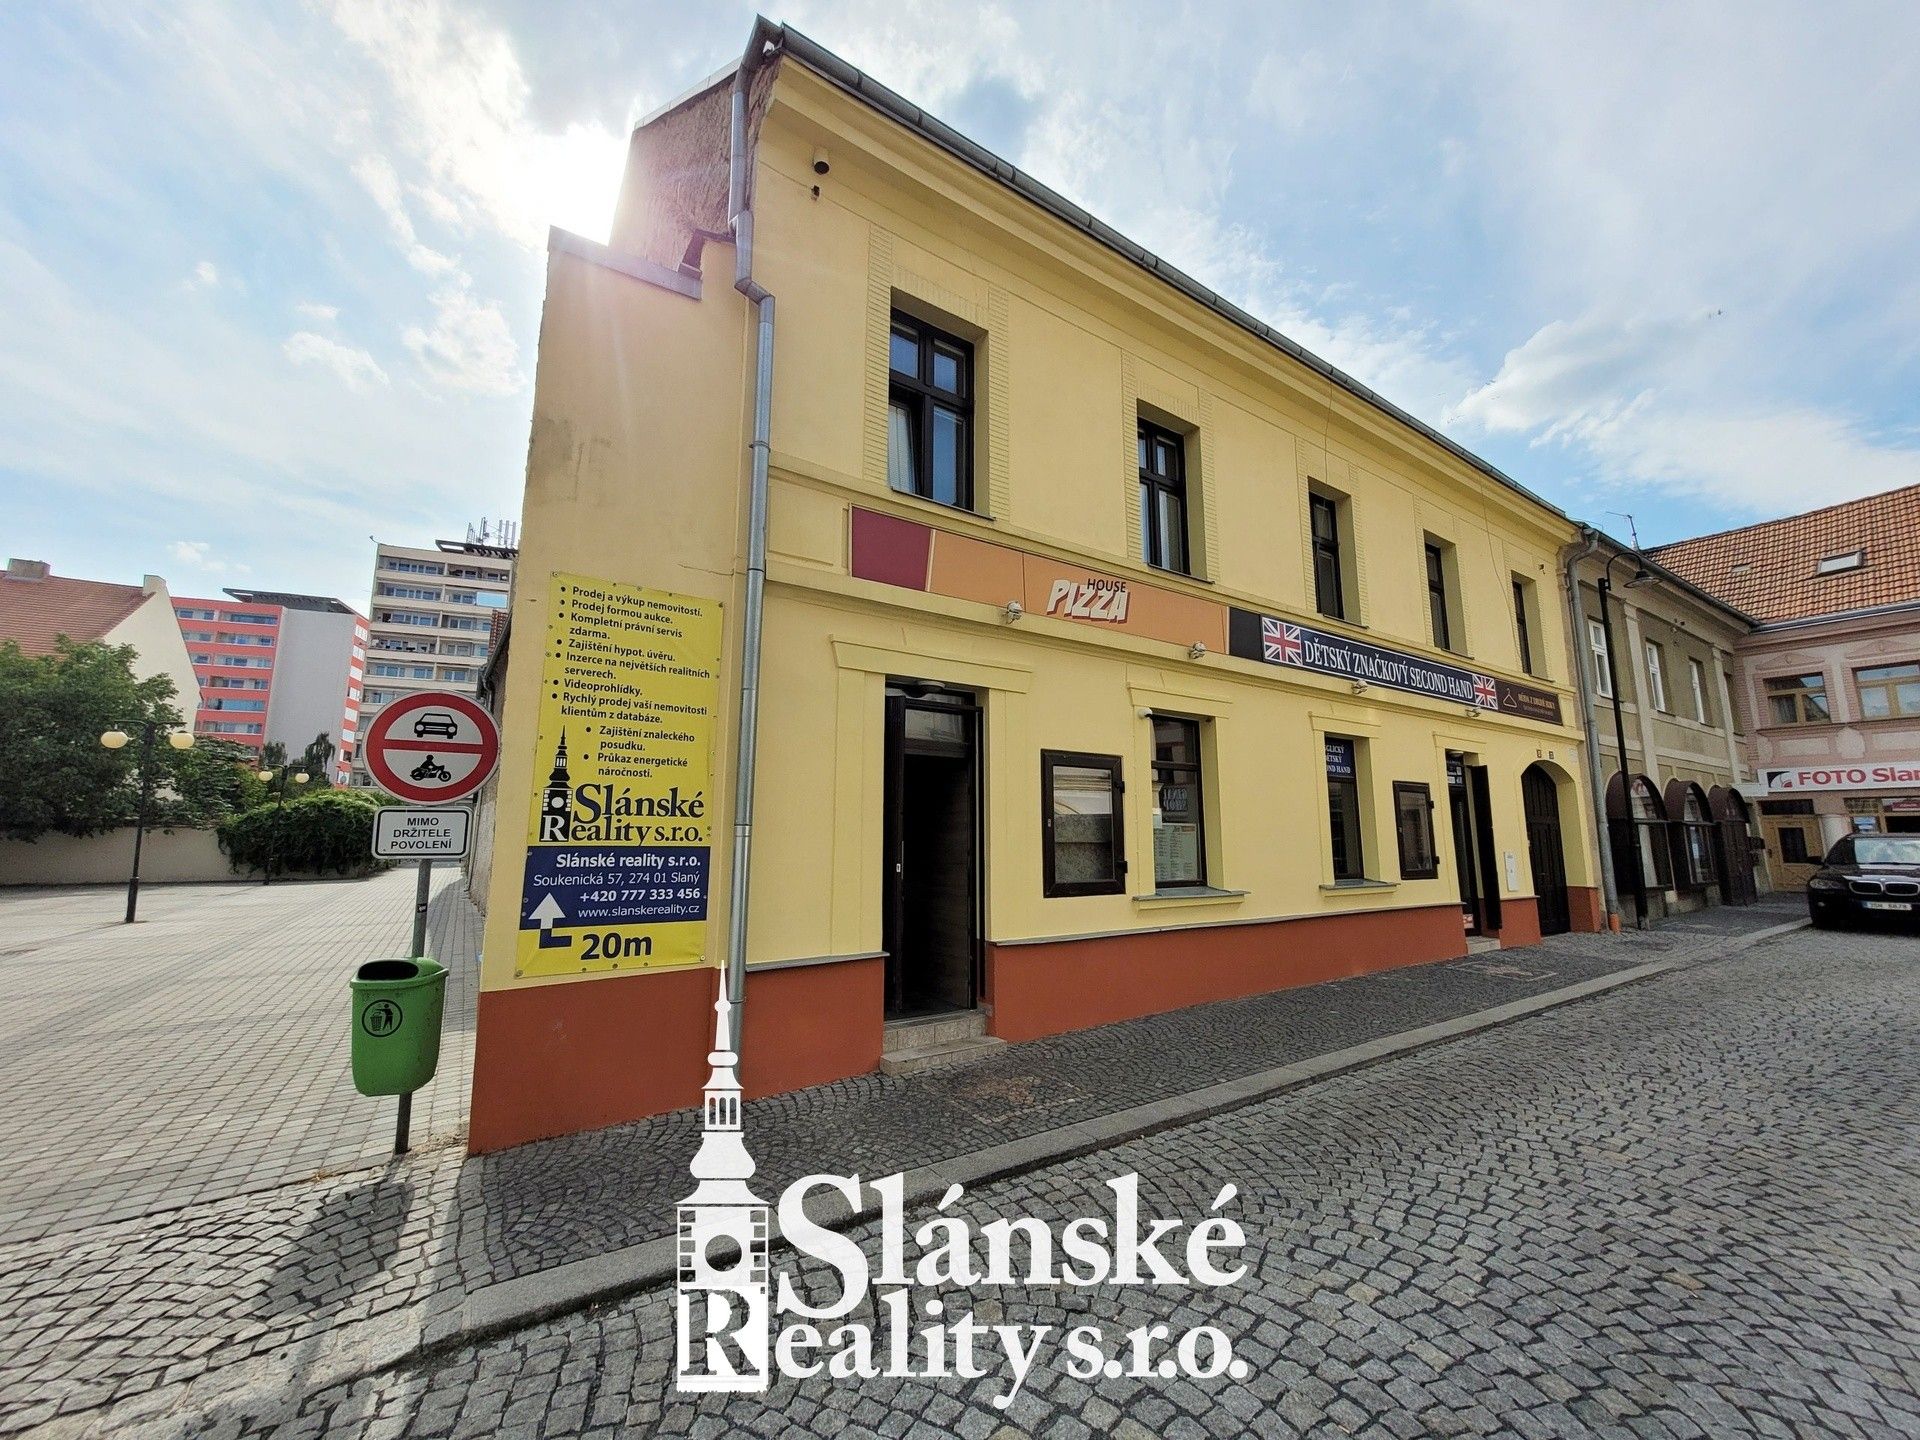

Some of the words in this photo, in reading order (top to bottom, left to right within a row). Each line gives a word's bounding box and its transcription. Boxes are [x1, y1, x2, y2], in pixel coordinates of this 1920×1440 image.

[1087, 578, 1126, 593] HOUSE
[573, 587, 605, 601] Prodej
[616, 593, 645, 607] výkup
[1046, 579, 1130, 624] PIZZA
[572, 600, 605, 614] Prodej
[607, 606, 642, 619] formou
[644, 613, 673, 624] aukce.
[570, 627, 610, 639] zdarma.
[571, 613, 622, 630] Kompletní
[625, 622, 654, 634] právní
[656, 628, 682, 637] servis
[569, 639, 612, 654] Zajištění
[615, 646, 644, 659] hypot.
[647, 651, 675, 661] úvěru.
[565, 666, 616, 679] serverech.
[567, 652, 603, 665] Inzerce
[620, 660, 666, 675] největších
[669, 666, 710, 678] realitních
[1304, 638, 1351, 672] DĚTSKÝ
[1353, 652, 1408, 685] ZNAČKOVÝ
[1410, 667, 1447, 693] SECOND
[1448, 677, 1473, 699] HAND
[564, 679, 642, 696] Videoprohlídky.
[563, 693, 596, 706] Rychlý
[599, 698, 631, 709] prodej
[634, 700, 651, 709] vaší
[654, 703, 707, 715] nemovitosti
[561, 706, 606, 718] klientům
[617, 711, 663, 723] databáze.
[600, 726, 641, 738] Zajištění
[644, 729, 695, 742] znaleckého
[600, 740, 645, 751] posudku.
[598, 753, 631, 764] Průkaz
[634, 755, 688, 767] energetické
[1798, 769, 1866, 785] FOTO
[573, 783, 704, 824] Slánské
[407, 818, 439, 826] MIMO
[393, 828, 451, 837] DRŽITELE
[542, 815, 651, 846] Reality
[654, 826, 702, 842] s.r.o.
[391, 838, 451, 849] POVOLENÍ
[557, 853, 615, 868] Slánské
[619, 854, 664, 869] reality
[668, 856, 700, 867] s.r.o.
[534, 873, 603, 886] Soukenická
[608, 873, 624, 885] 57,
[629, 873, 649, 884] 274
[654, 873, 666, 883] 01
[671, 871, 699, 885] Slaný
[580, 891, 616, 902] +420
[621, 890, 645, 901] 777
[649, 889, 673, 900] 333
[677, 888, 700, 899] 456
[579, 905, 699, 918] www.slanskereality.cz
[581, 933, 652, 960] 20m
